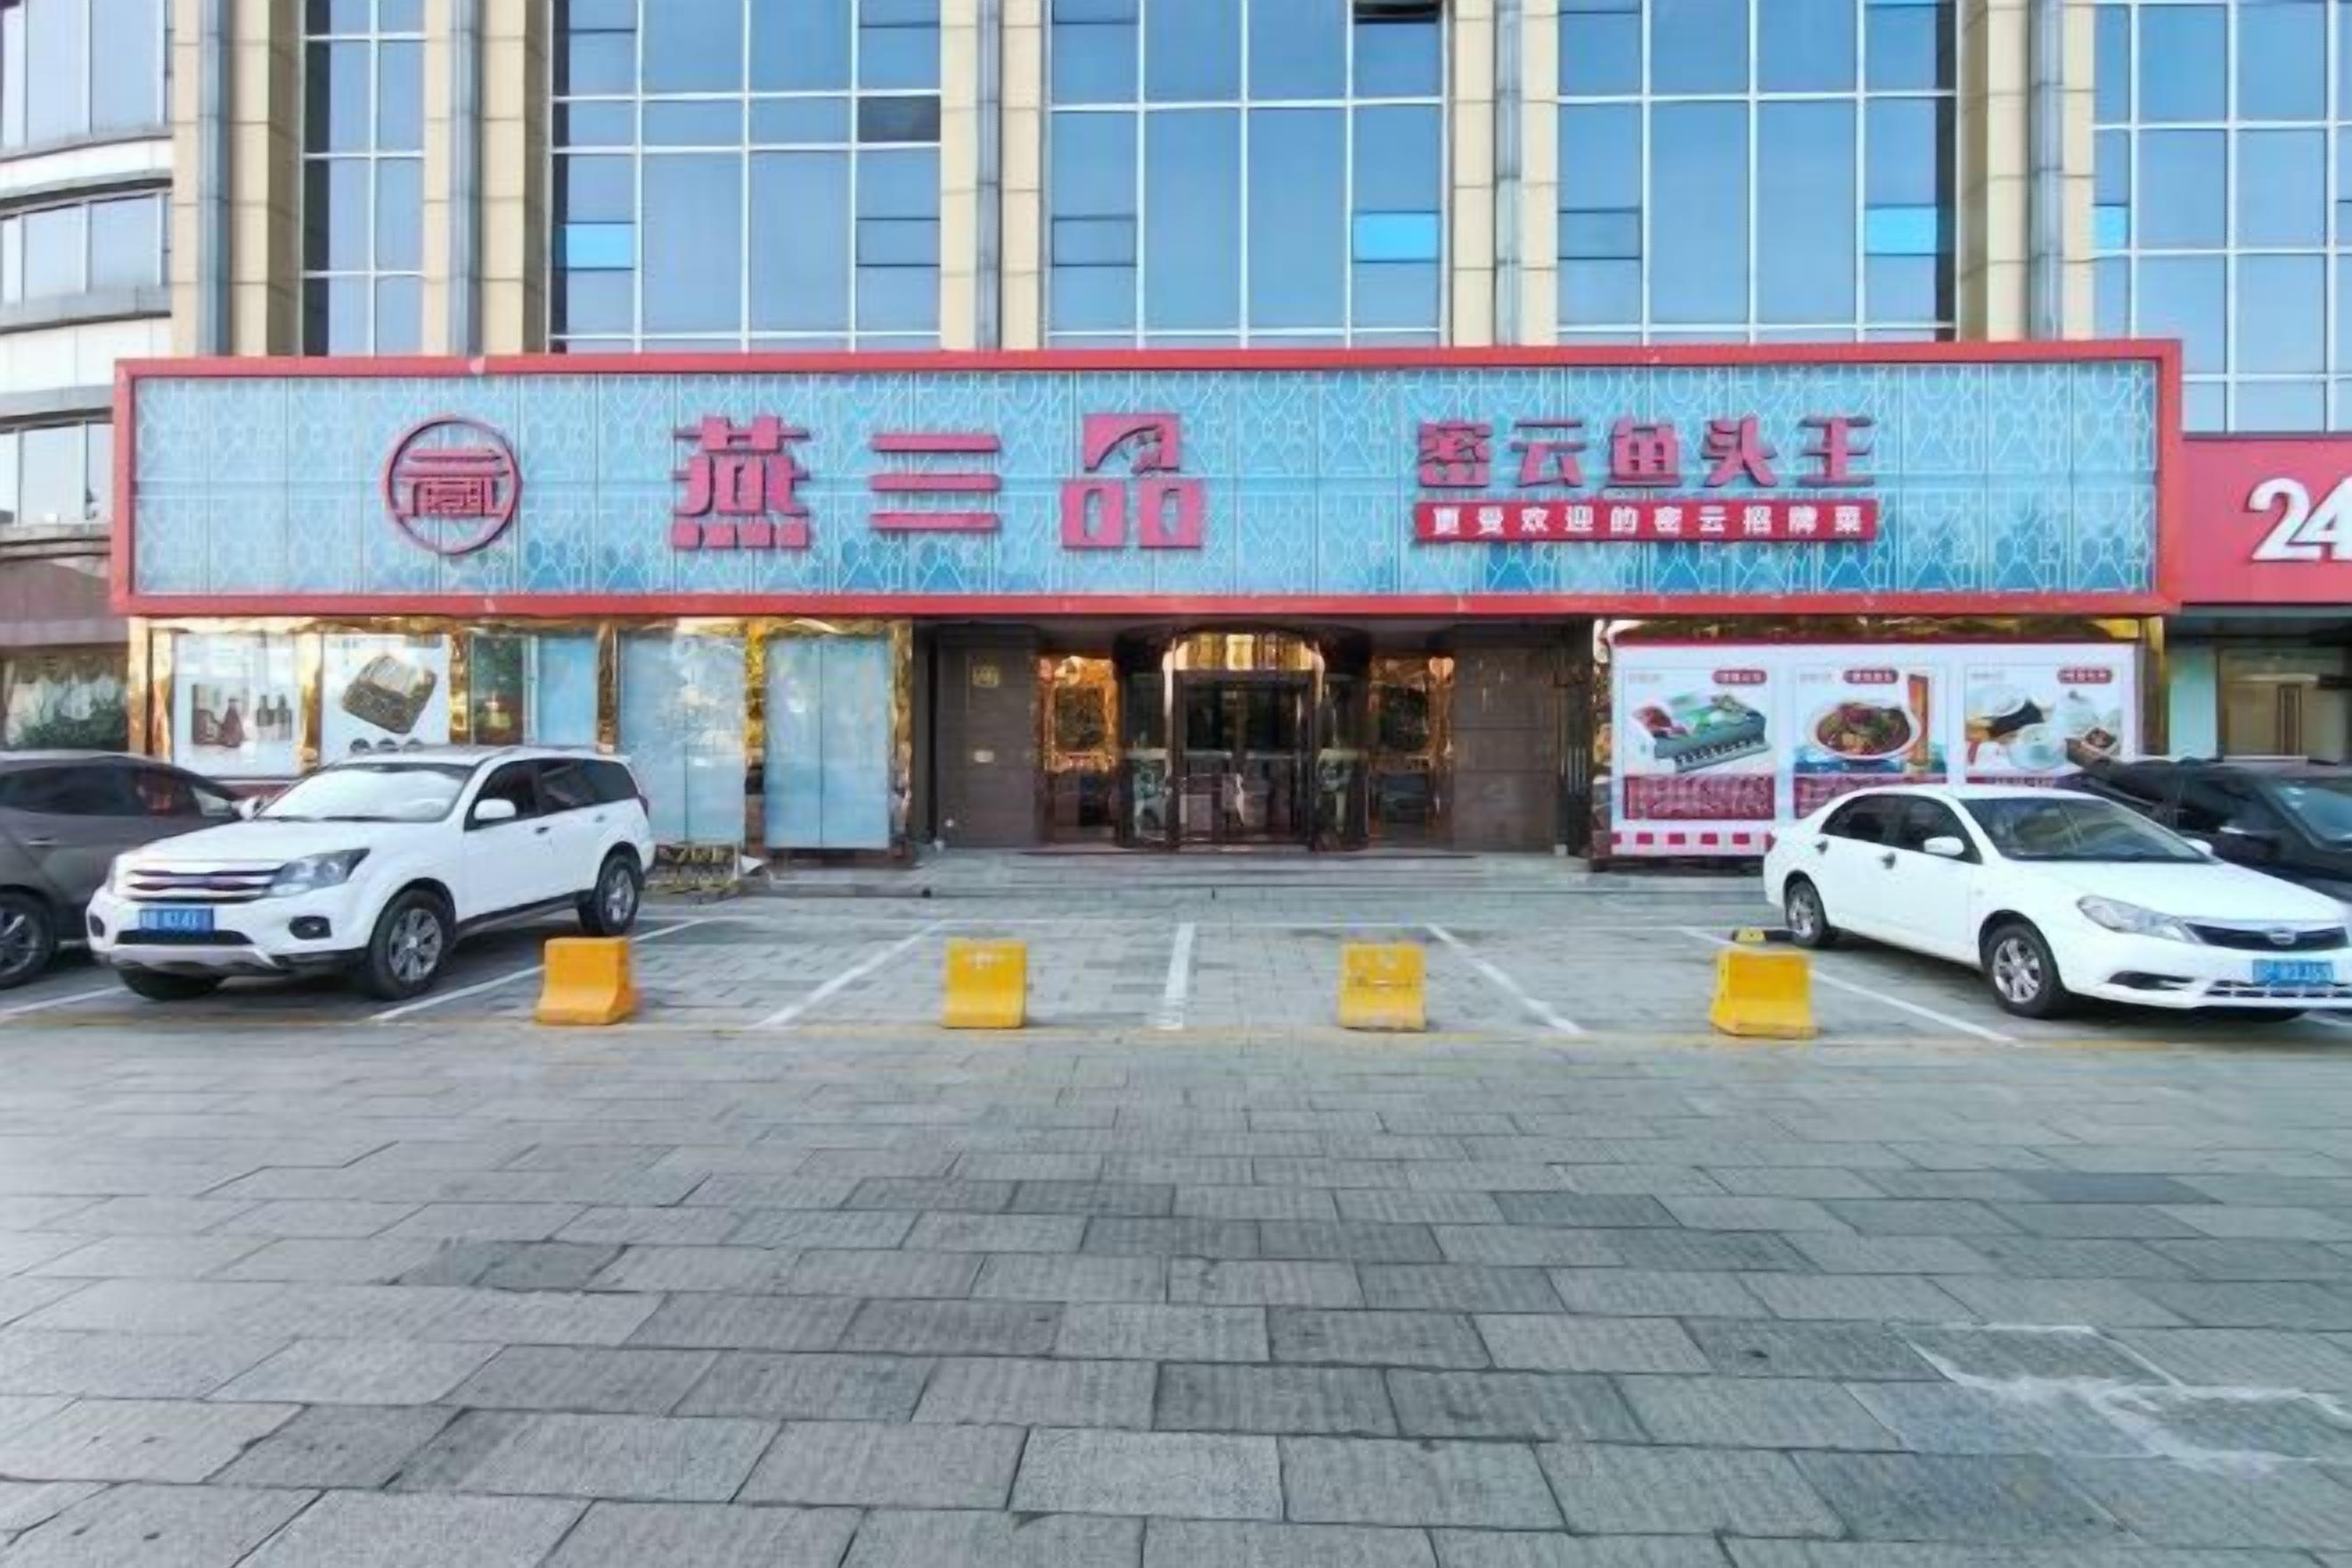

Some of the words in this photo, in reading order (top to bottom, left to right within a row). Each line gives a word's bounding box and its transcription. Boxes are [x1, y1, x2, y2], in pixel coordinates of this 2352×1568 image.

[672, 412, 1205, 550] 燕三品
[1417, 415, 1874, 488] 密云鱼头王
[2247, 475, 2352, 561] 24
